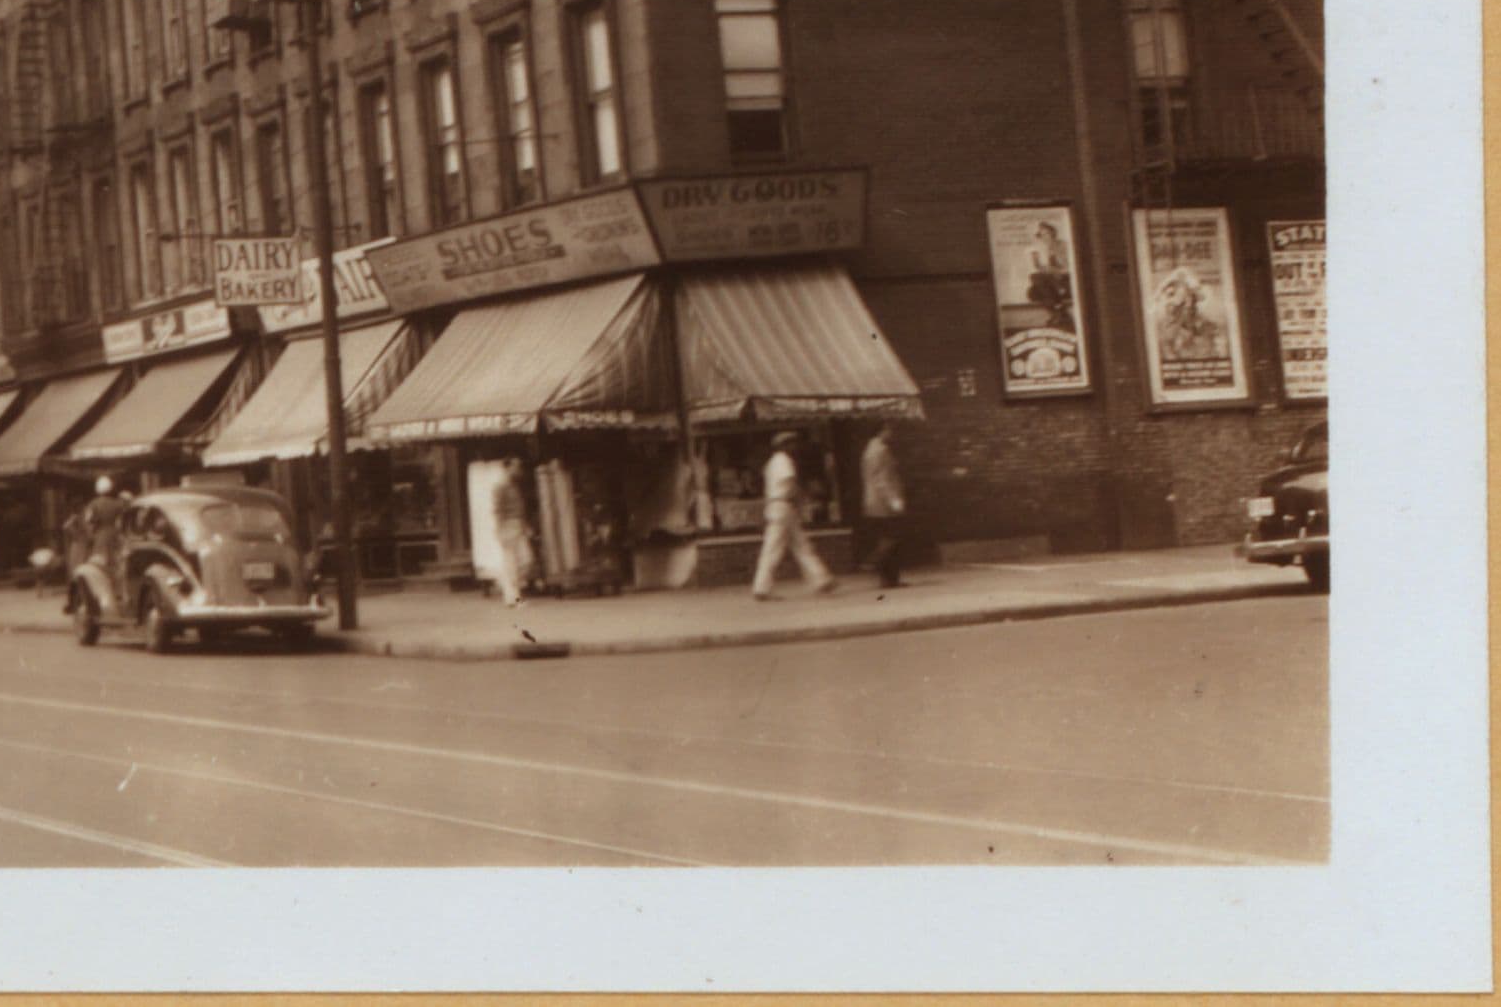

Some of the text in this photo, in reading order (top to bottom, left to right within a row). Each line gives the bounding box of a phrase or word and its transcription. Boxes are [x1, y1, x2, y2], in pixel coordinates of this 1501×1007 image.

[662, 177, 838, 208] DRY GOODS
[436, 217, 552, 265] SHOES
[1274, 225, 1325, 247] STAT
[216, 243, 295, 271] DAIRY
[219, 275, 298, 301] BAKERY
